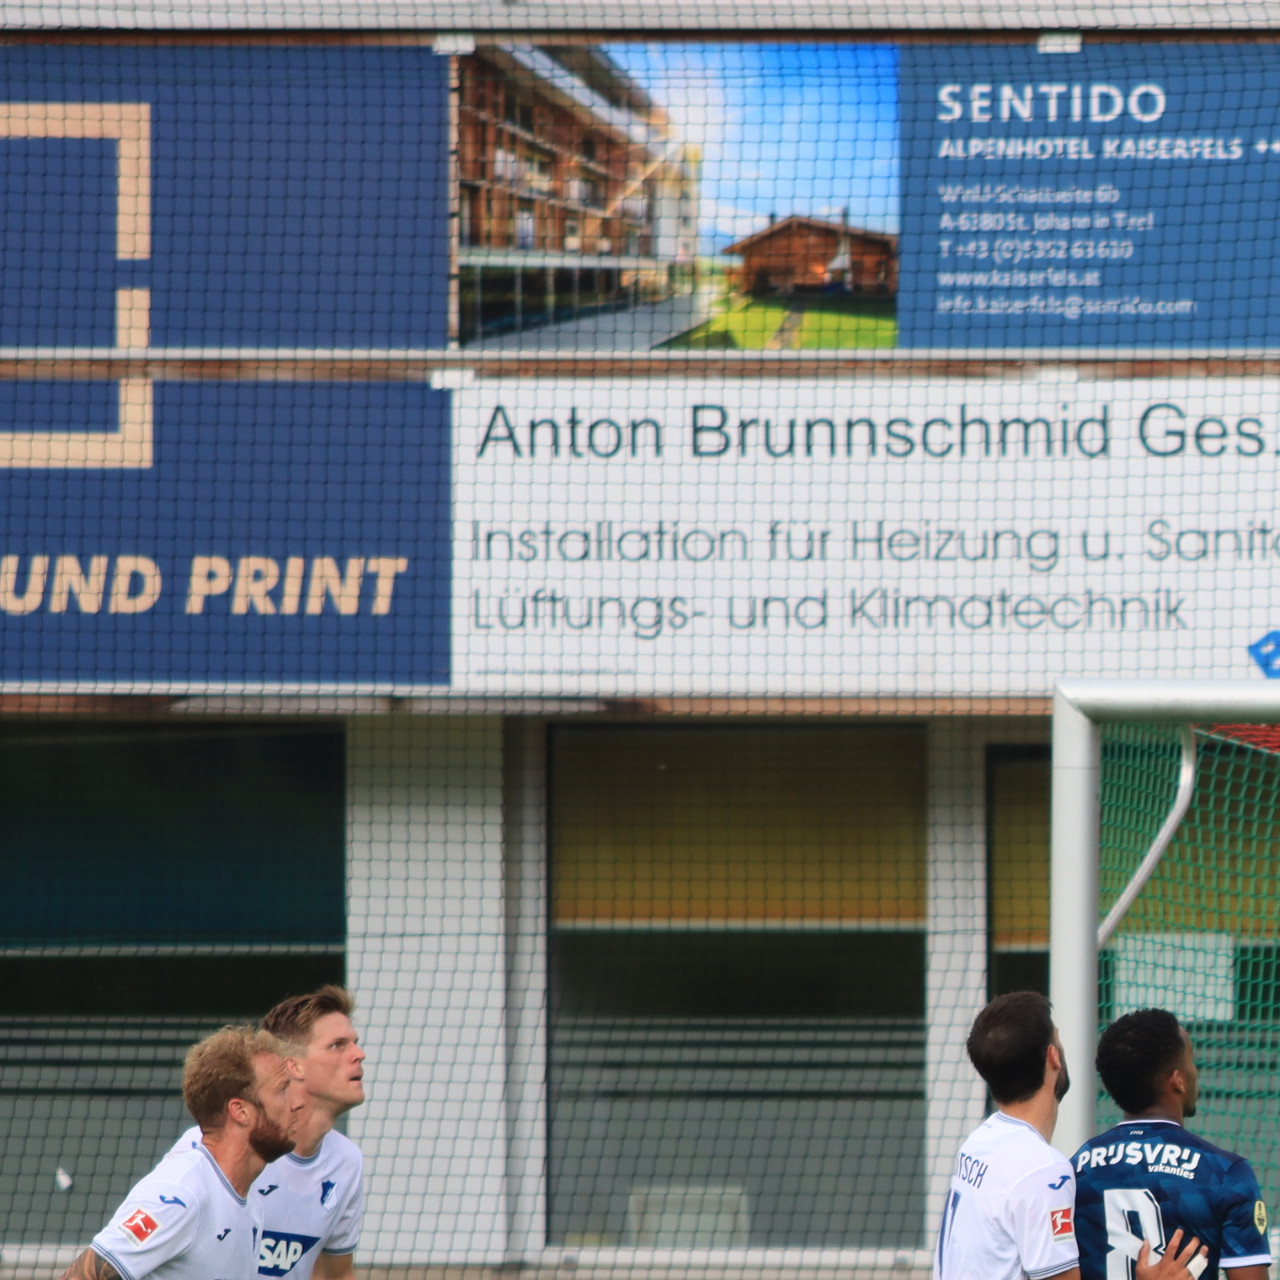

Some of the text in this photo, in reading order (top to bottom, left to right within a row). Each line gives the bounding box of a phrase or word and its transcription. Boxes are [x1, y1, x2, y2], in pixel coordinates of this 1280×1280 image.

[937, 83, 1166, 123] SENTIDO
[938, 138, 1243, 160] ALPENHOTEL KAISERFELS
[1033, 213, 1091, 234] Johann
[477, 405, 663, 458] Anton
[691, 405, 1110, 458] Brunnschmid
[472, 520, 748, 562] Installation
[768, 518, 832, 562] für
[852, 520, 1060, 573] Heizung
[1082, 530, 1127, 562] u.
[0, 554, 408, 615] UND PRINT
[472, 588, 1189, 640] Lüftungs- und Klimatechnik
[1148, 1164, 1195, 1180] vakanties
[258, 1238, 303, 1270] SAP
